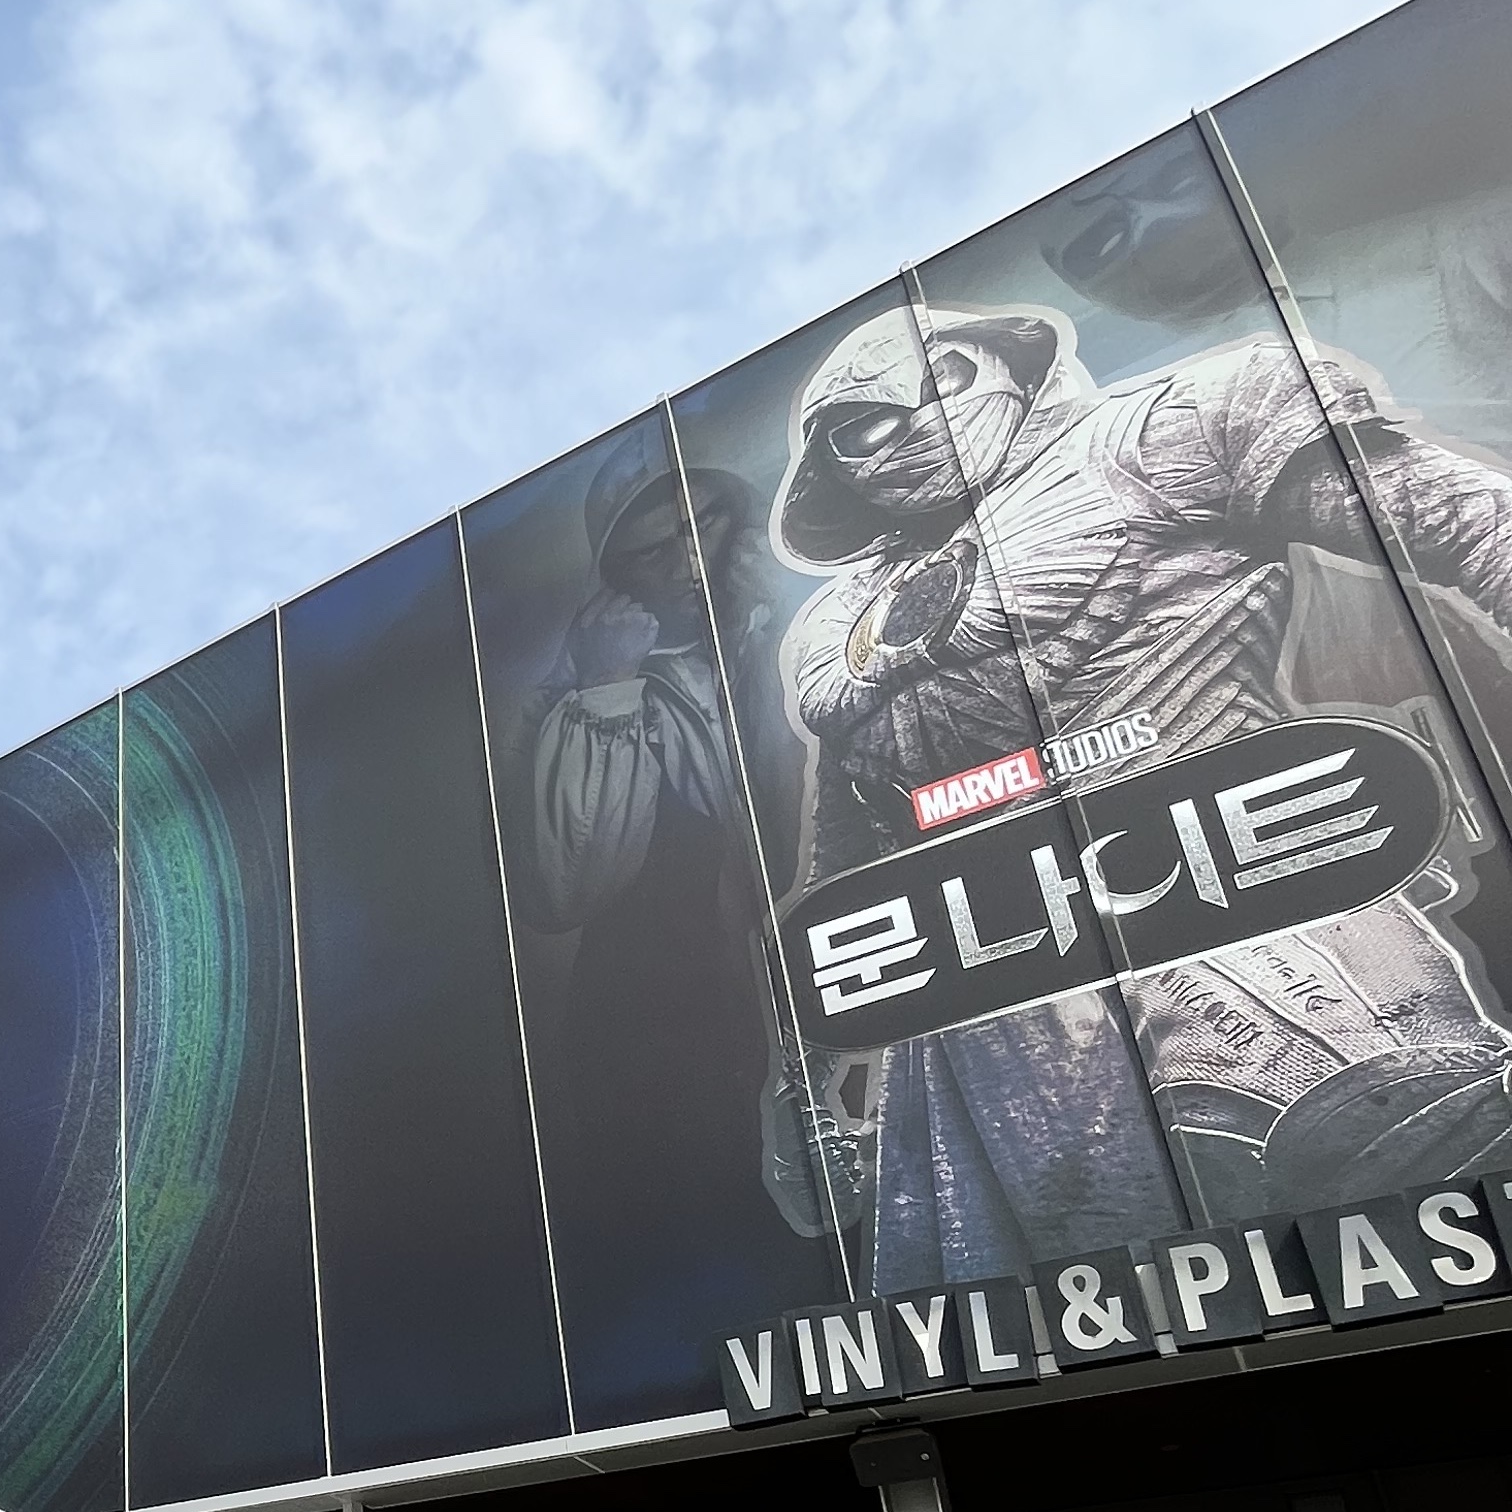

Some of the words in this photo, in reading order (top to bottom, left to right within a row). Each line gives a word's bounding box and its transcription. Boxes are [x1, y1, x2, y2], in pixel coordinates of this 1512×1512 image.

[805, 748, 1395, 1017] 문나이트
[917, 755, 1040, 825] MARVEL
[1042, 712, 1160, 779] STUDIOS
[725, 1290, 1020, 1411] VINYL
[1057, 1264, 1138, 1351] &
[1168, 1182, 1512, 1332] PLAS
